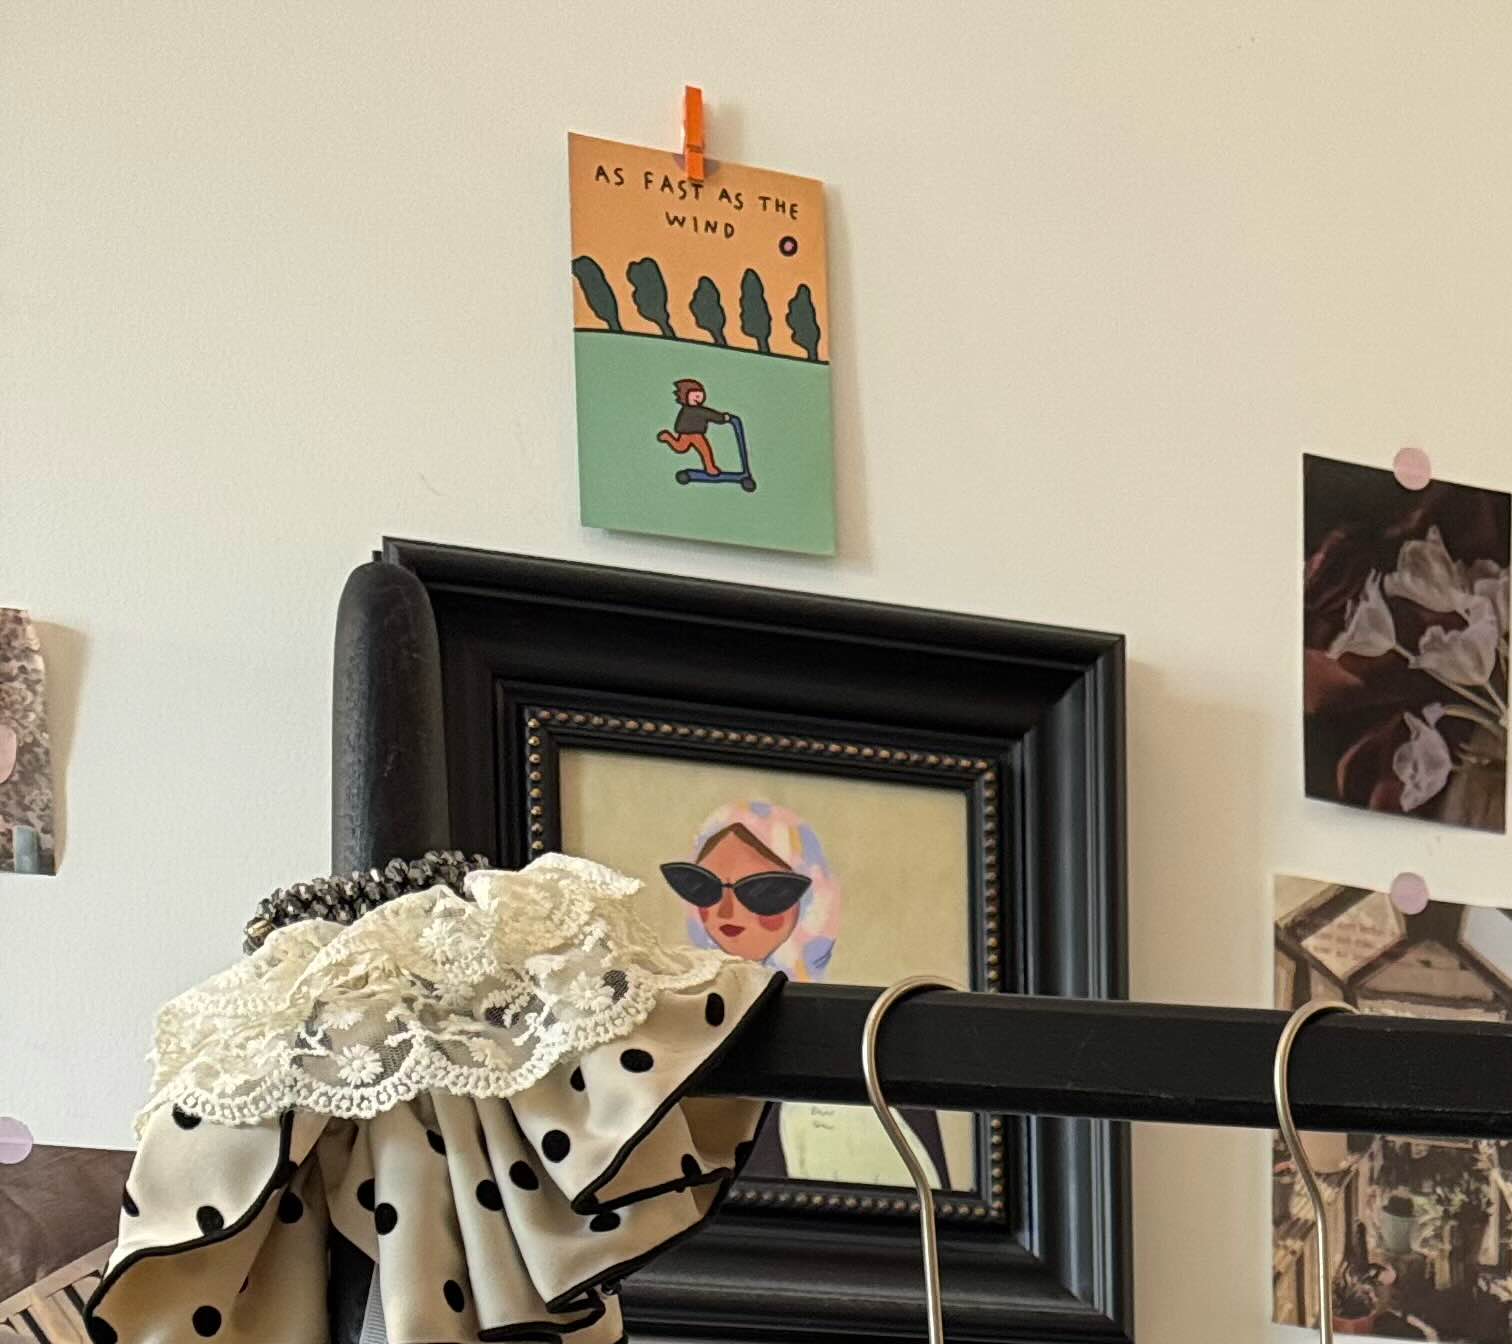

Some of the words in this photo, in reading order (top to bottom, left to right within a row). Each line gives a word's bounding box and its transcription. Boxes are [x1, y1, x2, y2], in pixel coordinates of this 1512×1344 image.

[594, 165, 624, 186] AS
[643, 171, 705, 200] FAST
[718, 188, 744, 210] AS
[758, 195, 799, 220] THE
[665, 211, 735, 239] WIND
